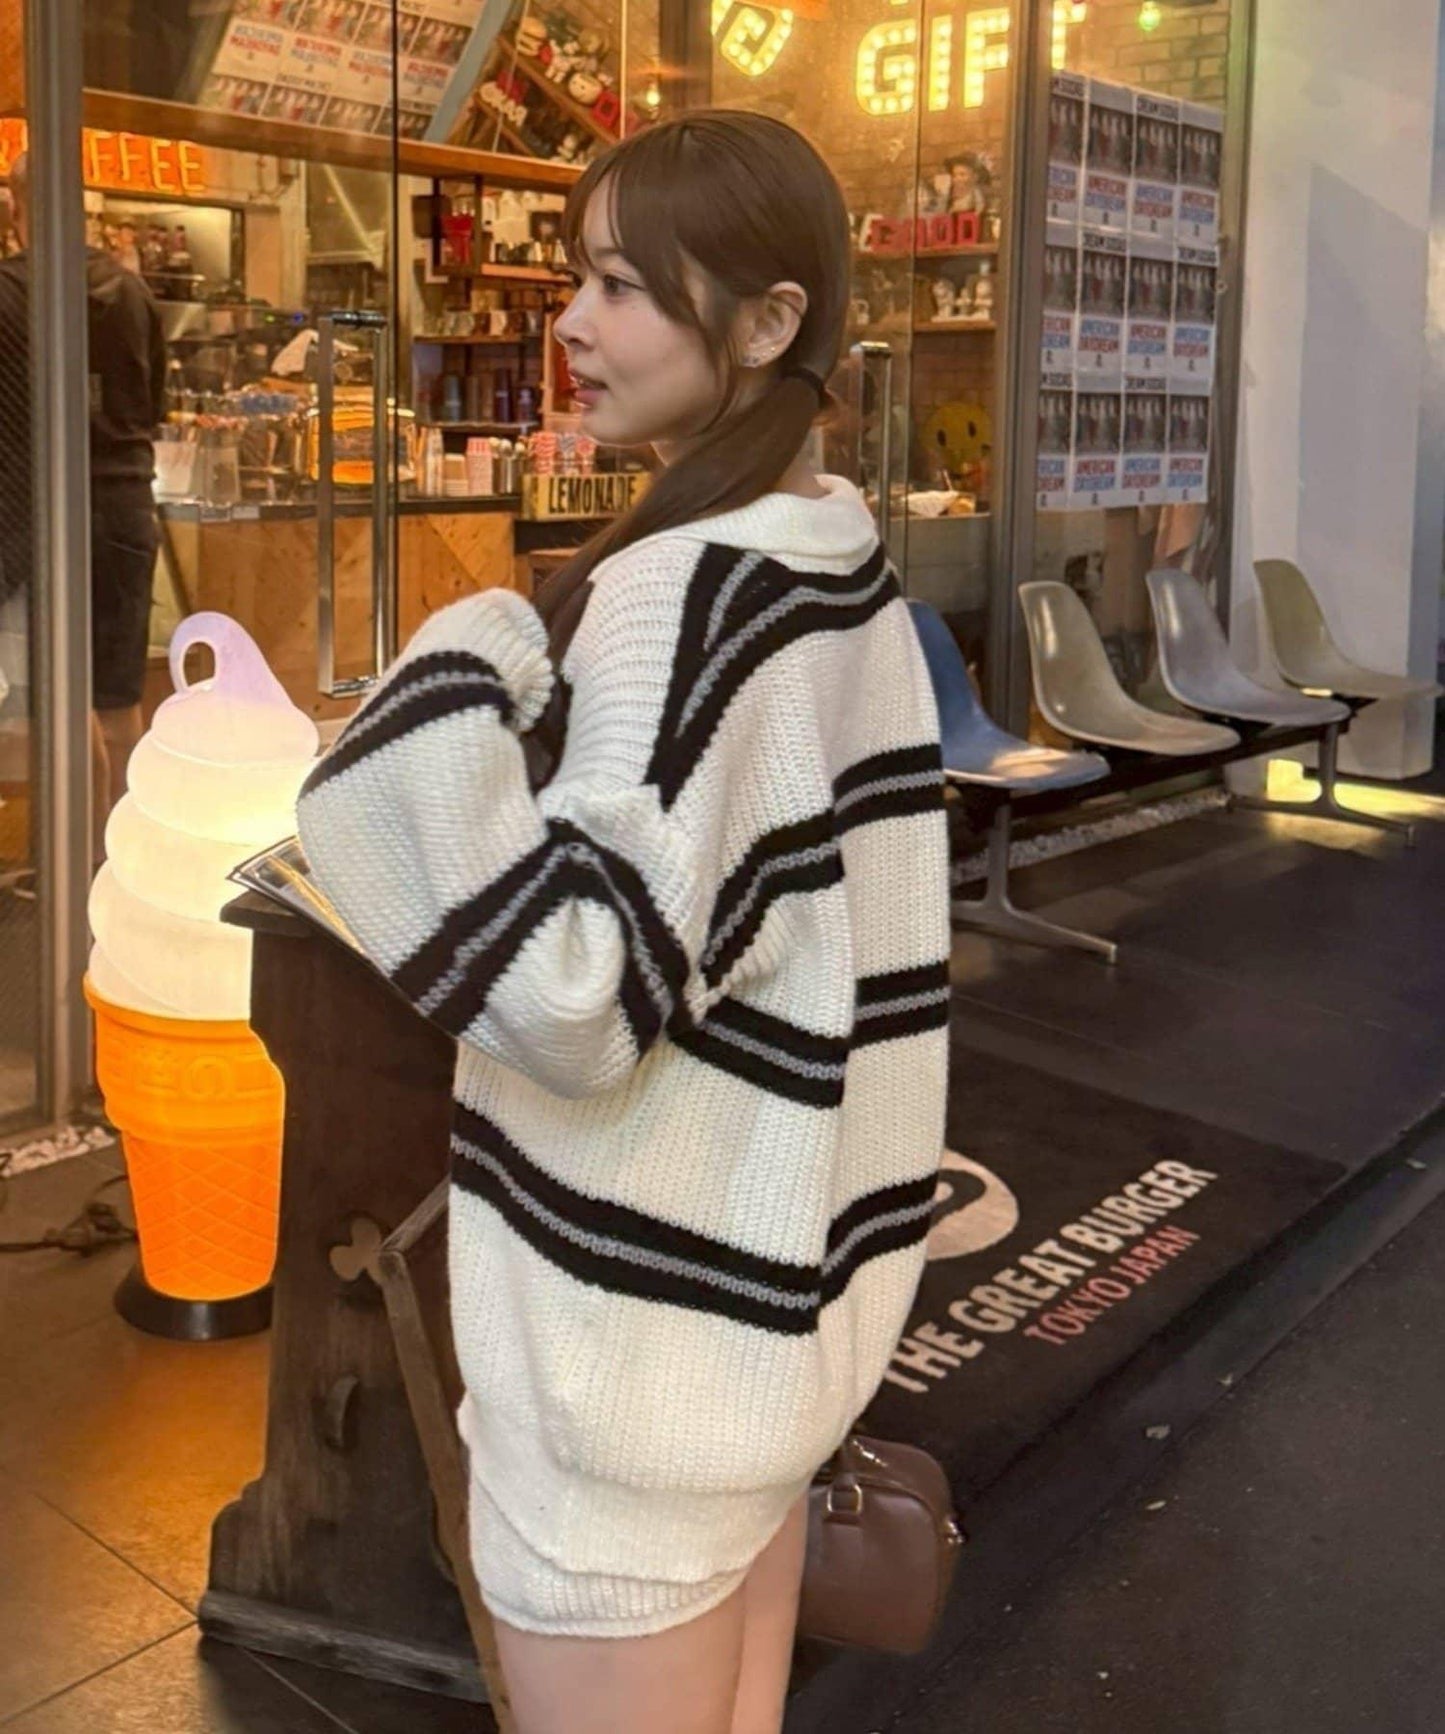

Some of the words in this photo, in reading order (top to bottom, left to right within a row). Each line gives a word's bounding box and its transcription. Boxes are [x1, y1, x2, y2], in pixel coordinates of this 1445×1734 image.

[87, 130, 207, 193] FFEE
[884, 1321, 985, 1393] THE
[949, 1240, 1096, 1333] GREAT
[1060, 1159, 1218, 1253] BURGER
[1024, 1277, 1131, 1345] TOKYO
[1110, 1225, 1200, 1285] JAPAN
